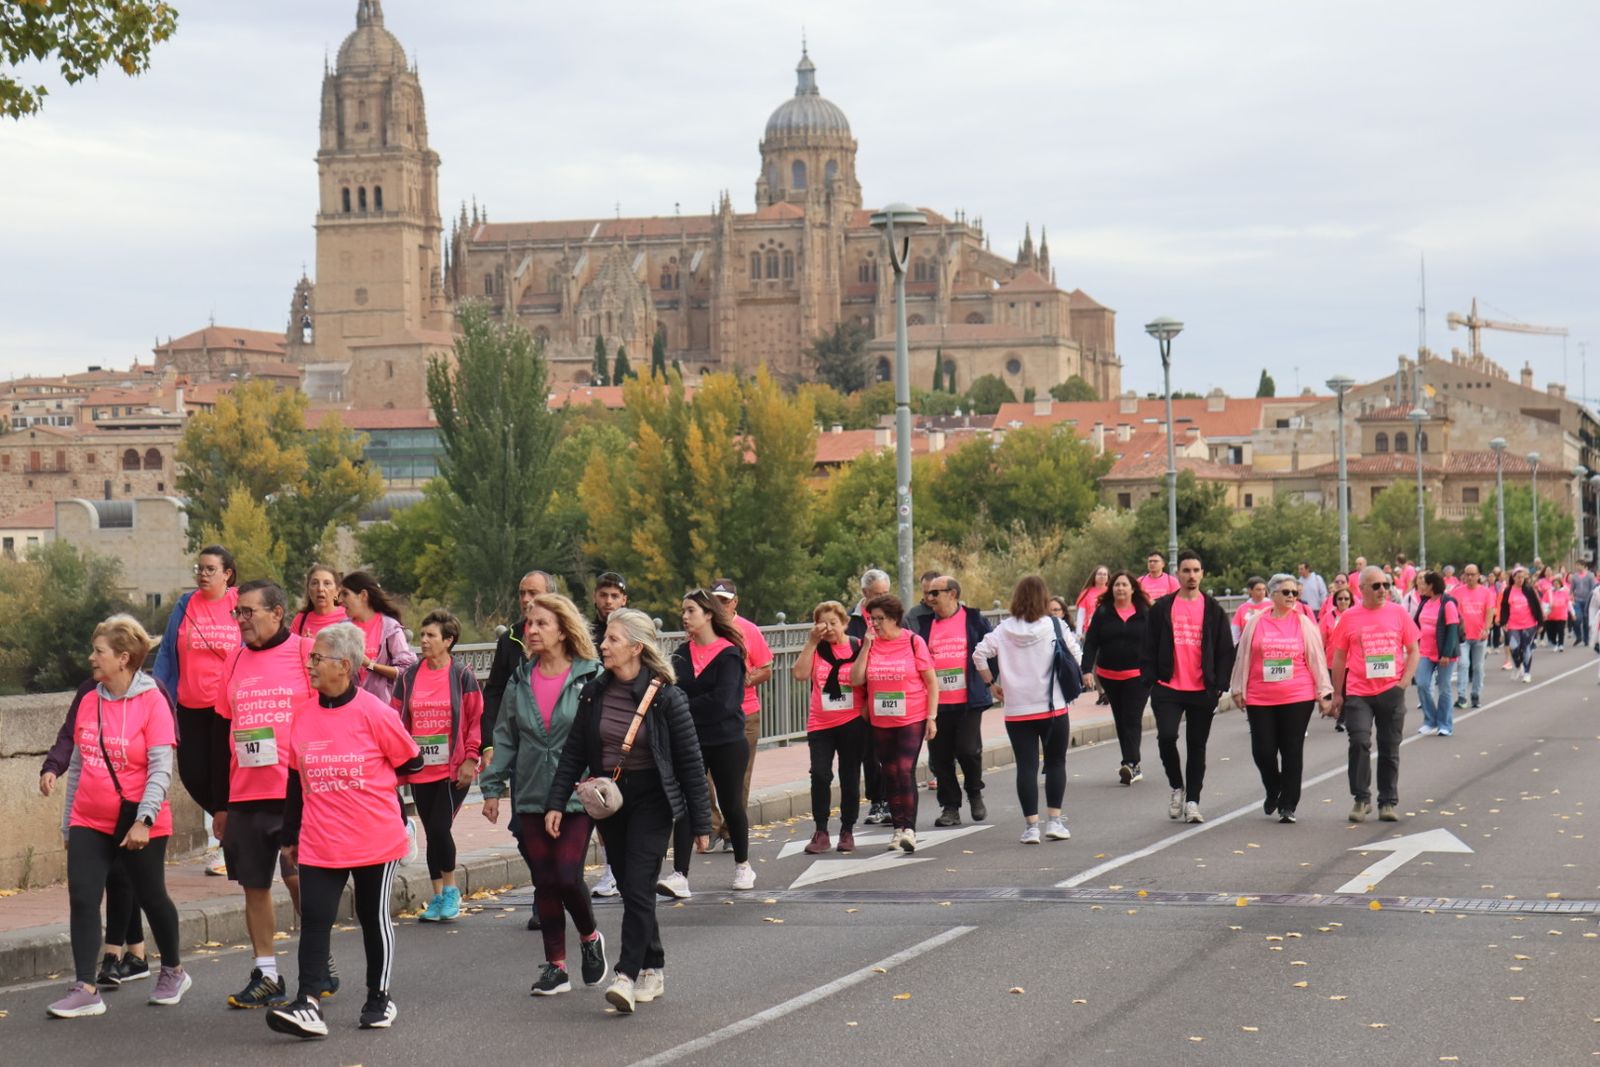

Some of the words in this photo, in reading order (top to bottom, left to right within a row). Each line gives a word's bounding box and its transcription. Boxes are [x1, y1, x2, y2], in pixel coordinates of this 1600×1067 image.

[236, 689, 249, 699] En
[251, 685, 293, 697] marcha
[237, 698, 276, 712] contra
[278, 698, 292, 709] el
[882, 700, 898, 708] 8121
[239, 711, 292, 725] cáncer
[245, 742, 260, 754] 147
[305, 754, 318, 764] En
[321, 752, 364, 762] marcha
[307, 765, 348, 778] contra
[350, 765, 364, 776] el
